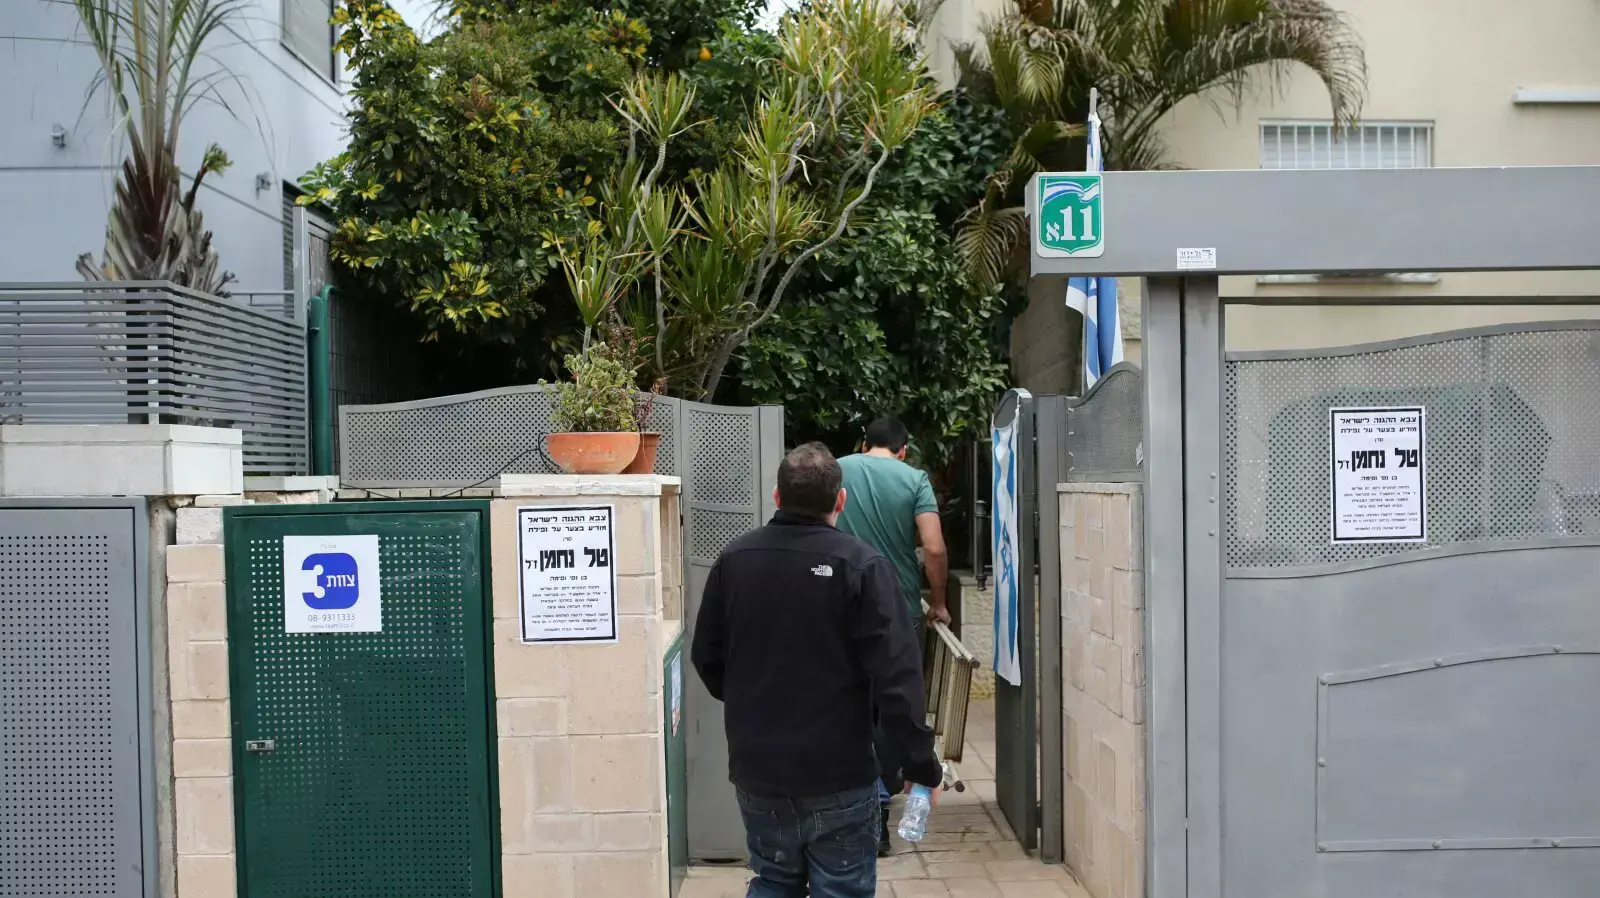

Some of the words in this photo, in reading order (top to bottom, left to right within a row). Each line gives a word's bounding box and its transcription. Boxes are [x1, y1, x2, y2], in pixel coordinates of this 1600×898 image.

[1352, 450, 1385, 472] נחמן
[1394, 448, 1418, 468] טל
[540, 550, 575, 572] נחמן
[584, 546, 608, 568] טל
[326, 574, 355, 587] צוות
[308, 613, 355, 622] 08-9311333
